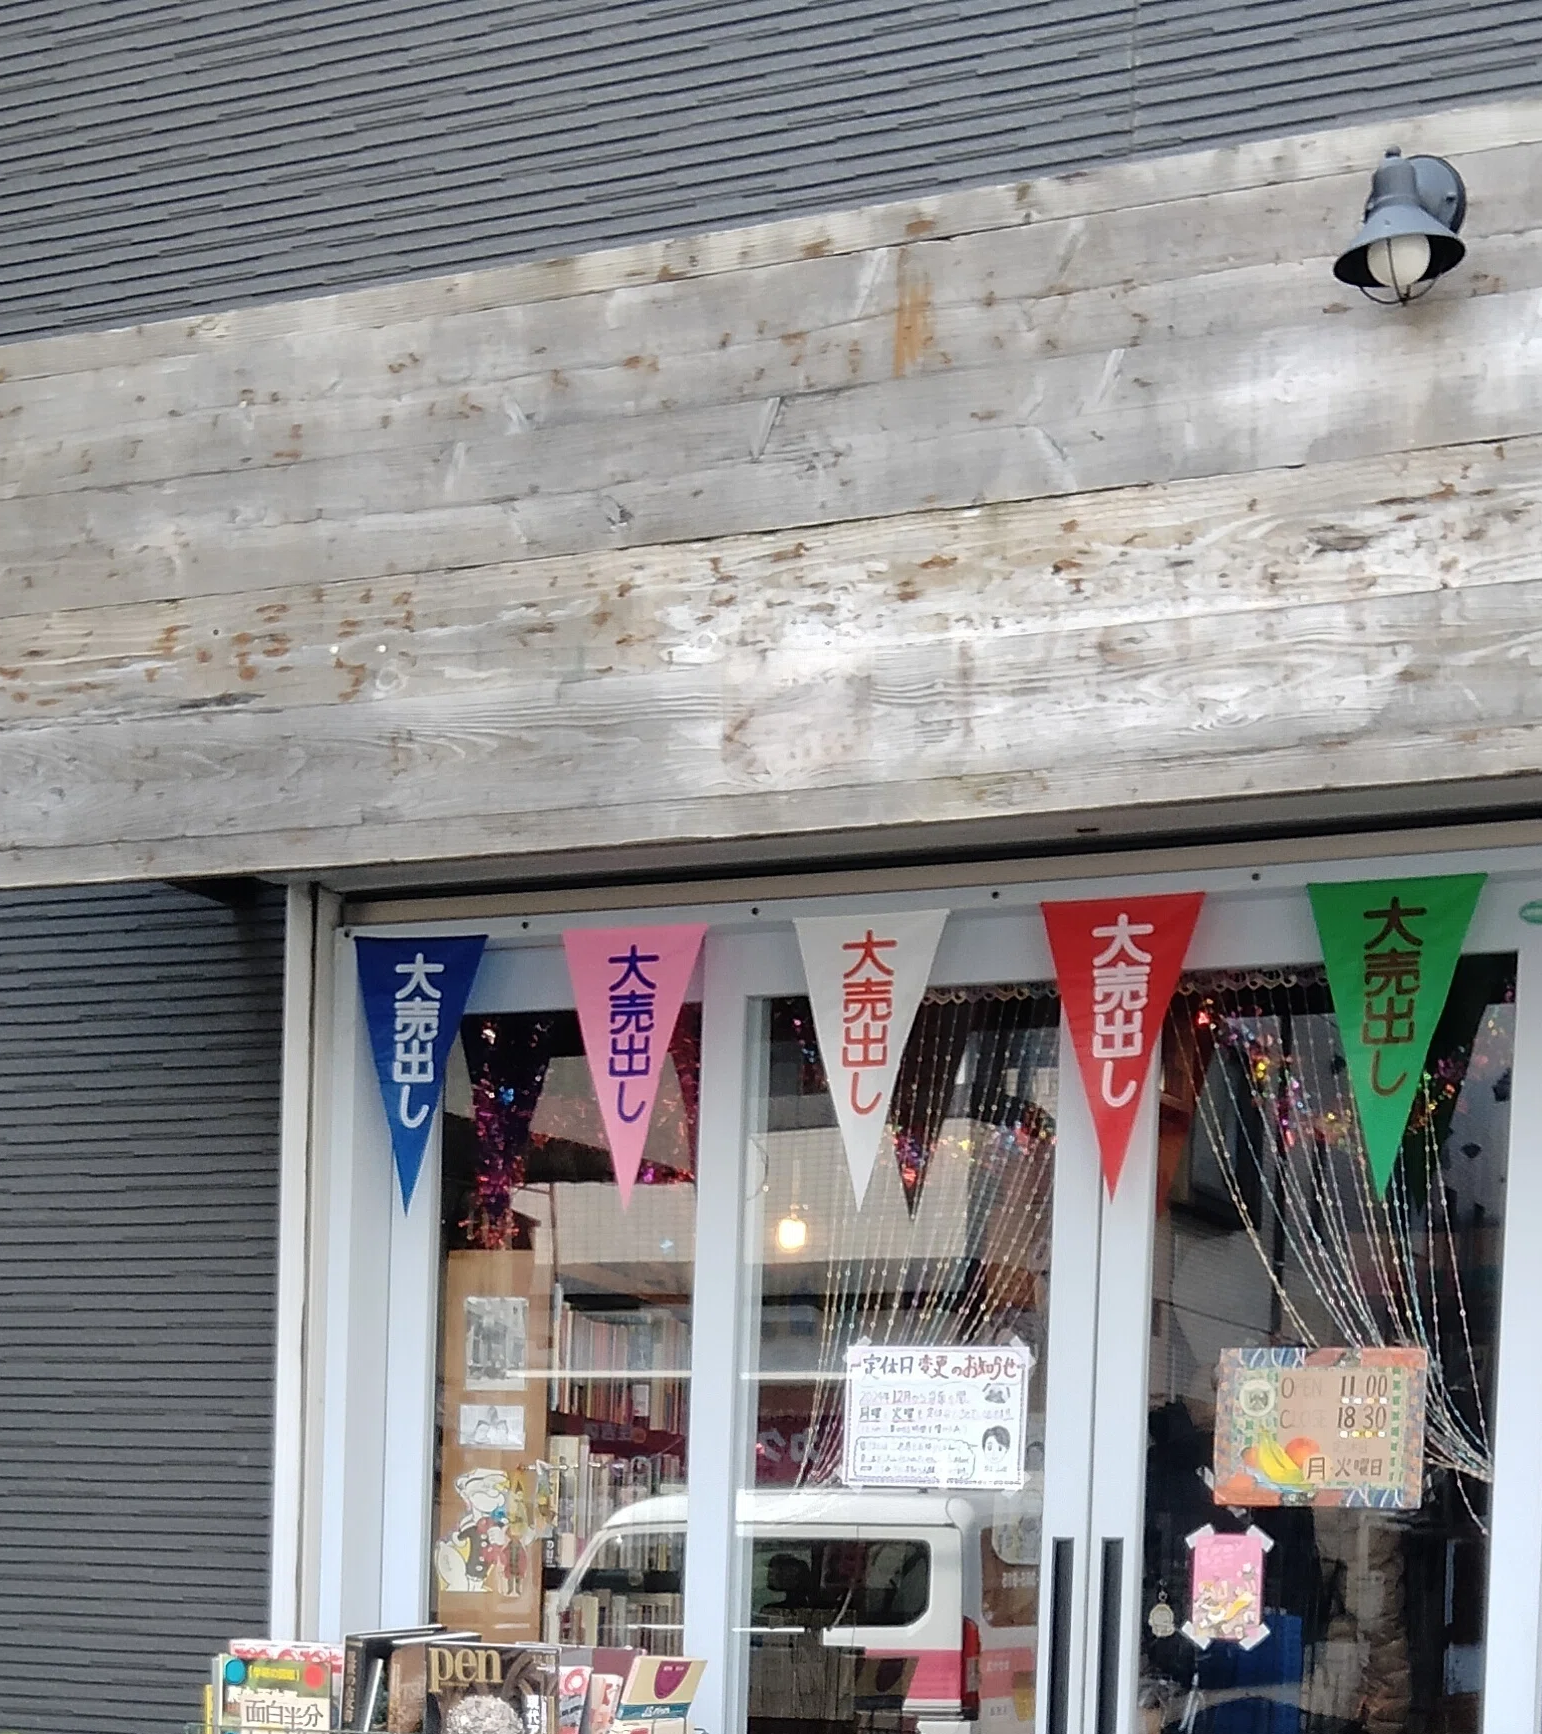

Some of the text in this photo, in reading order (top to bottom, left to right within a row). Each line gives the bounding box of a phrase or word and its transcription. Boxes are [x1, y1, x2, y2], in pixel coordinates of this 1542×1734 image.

[393, 952, 445, 1129] 大売出し
[608, 944, 660, 1124] 大売出し
[841, 929, 899, 1116] 大売出し
[1091, 913, 1155, 1109] 大売出し
[1363, 896, 1427, 1097] 大売出し
[862, 1353, 1018, 1381] 定休日変更のお知らせ
[245, 1699, 324, 1728] 面白半分
[427, 1647, 503, 1693] pen
